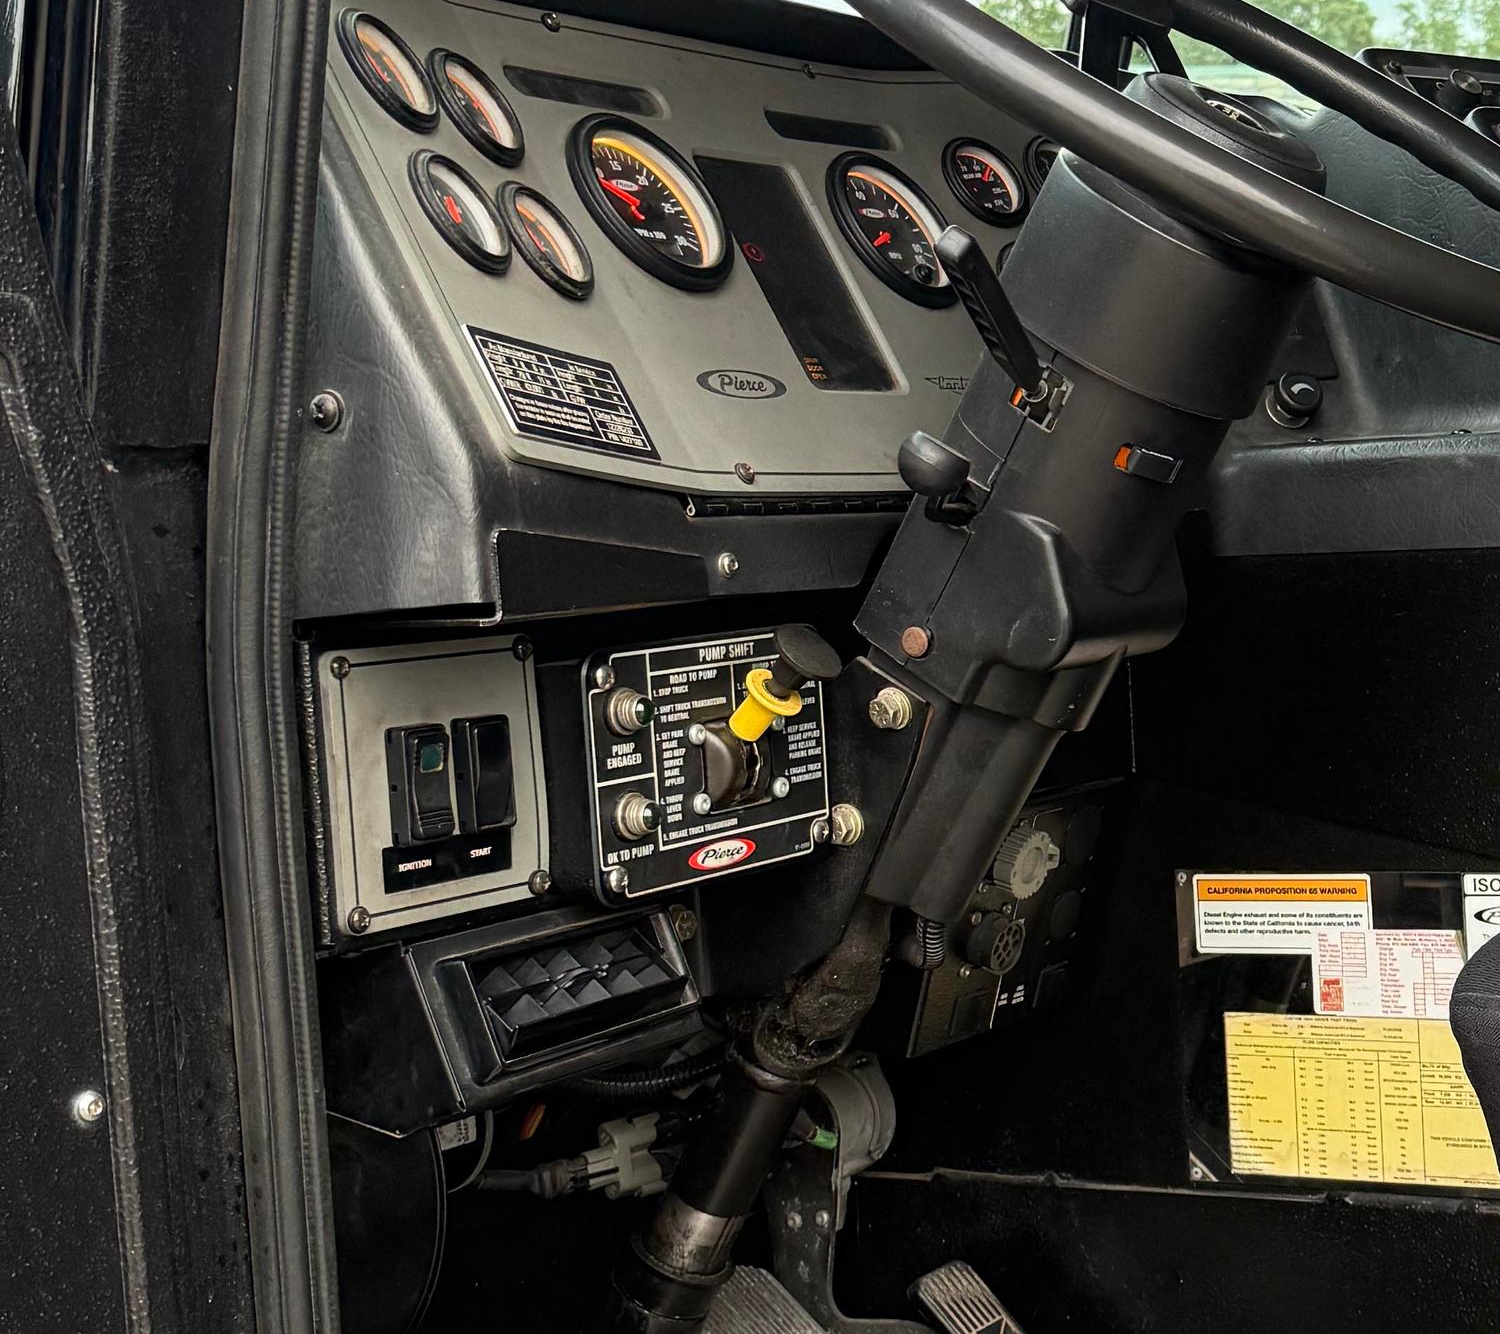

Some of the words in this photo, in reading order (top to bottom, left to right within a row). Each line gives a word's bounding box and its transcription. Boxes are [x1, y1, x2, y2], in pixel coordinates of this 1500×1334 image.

[609, 160, 622, 171] 15
[635, 175, 649, 186] 20
[661, 202, 675, 214] 25
[674, 235, 688, 247] 30
[717, 374, 768, 393] Pierce
[699, 645, 727, 662] PUMP
[729, 642, 756, 658] SHIFT
[669, 673, 687, 685] ROAD
[688, 671, 698, 681] TO
[698, 669, 718, 681] PUMP
[658, 687, 672, 697] STOP
[673, 685, 689, 695] TRUCK
[675, 701, 691, 712] TRUCK
[667, 712, 690, 722] NEUTRAL
[612, 742, 635, 756] PUMP
[607, 753, 642, 770] ENGAGED
[665, 776, 685, 787] APPLIED
[667, 803, 682, 814] LEVER
[669, 830, 688, 841] ENGAGE
[689, 827, 704, 837] TRUCK
[470, 846, 492, 858] START
[607, 851, 619, 865] OK
[620, 848, 631, 862] TO
[631, 844, 655, 859] PUMP
[701, 844, 744, 865] Pierce
[398, 858, 432, 872] IGNITION
[1207, 887, 1252, 895] CALIFORNIA
[1254, 887, 1308, 895] PROPOSITION
[1308, 887, 1318, 895] 65
[1319, 887, 1358, 895] WARNING
[1203, 911, 1222, 919] Diesel
[1222, 911, 1243, 920] Engine
[1244, 911, 1267, 919] exhaust
[1268, 911, 1280, 919] and
[1314, 911, 1352, 919] constituents
[1256, 928, 1293, 936] reproductive
